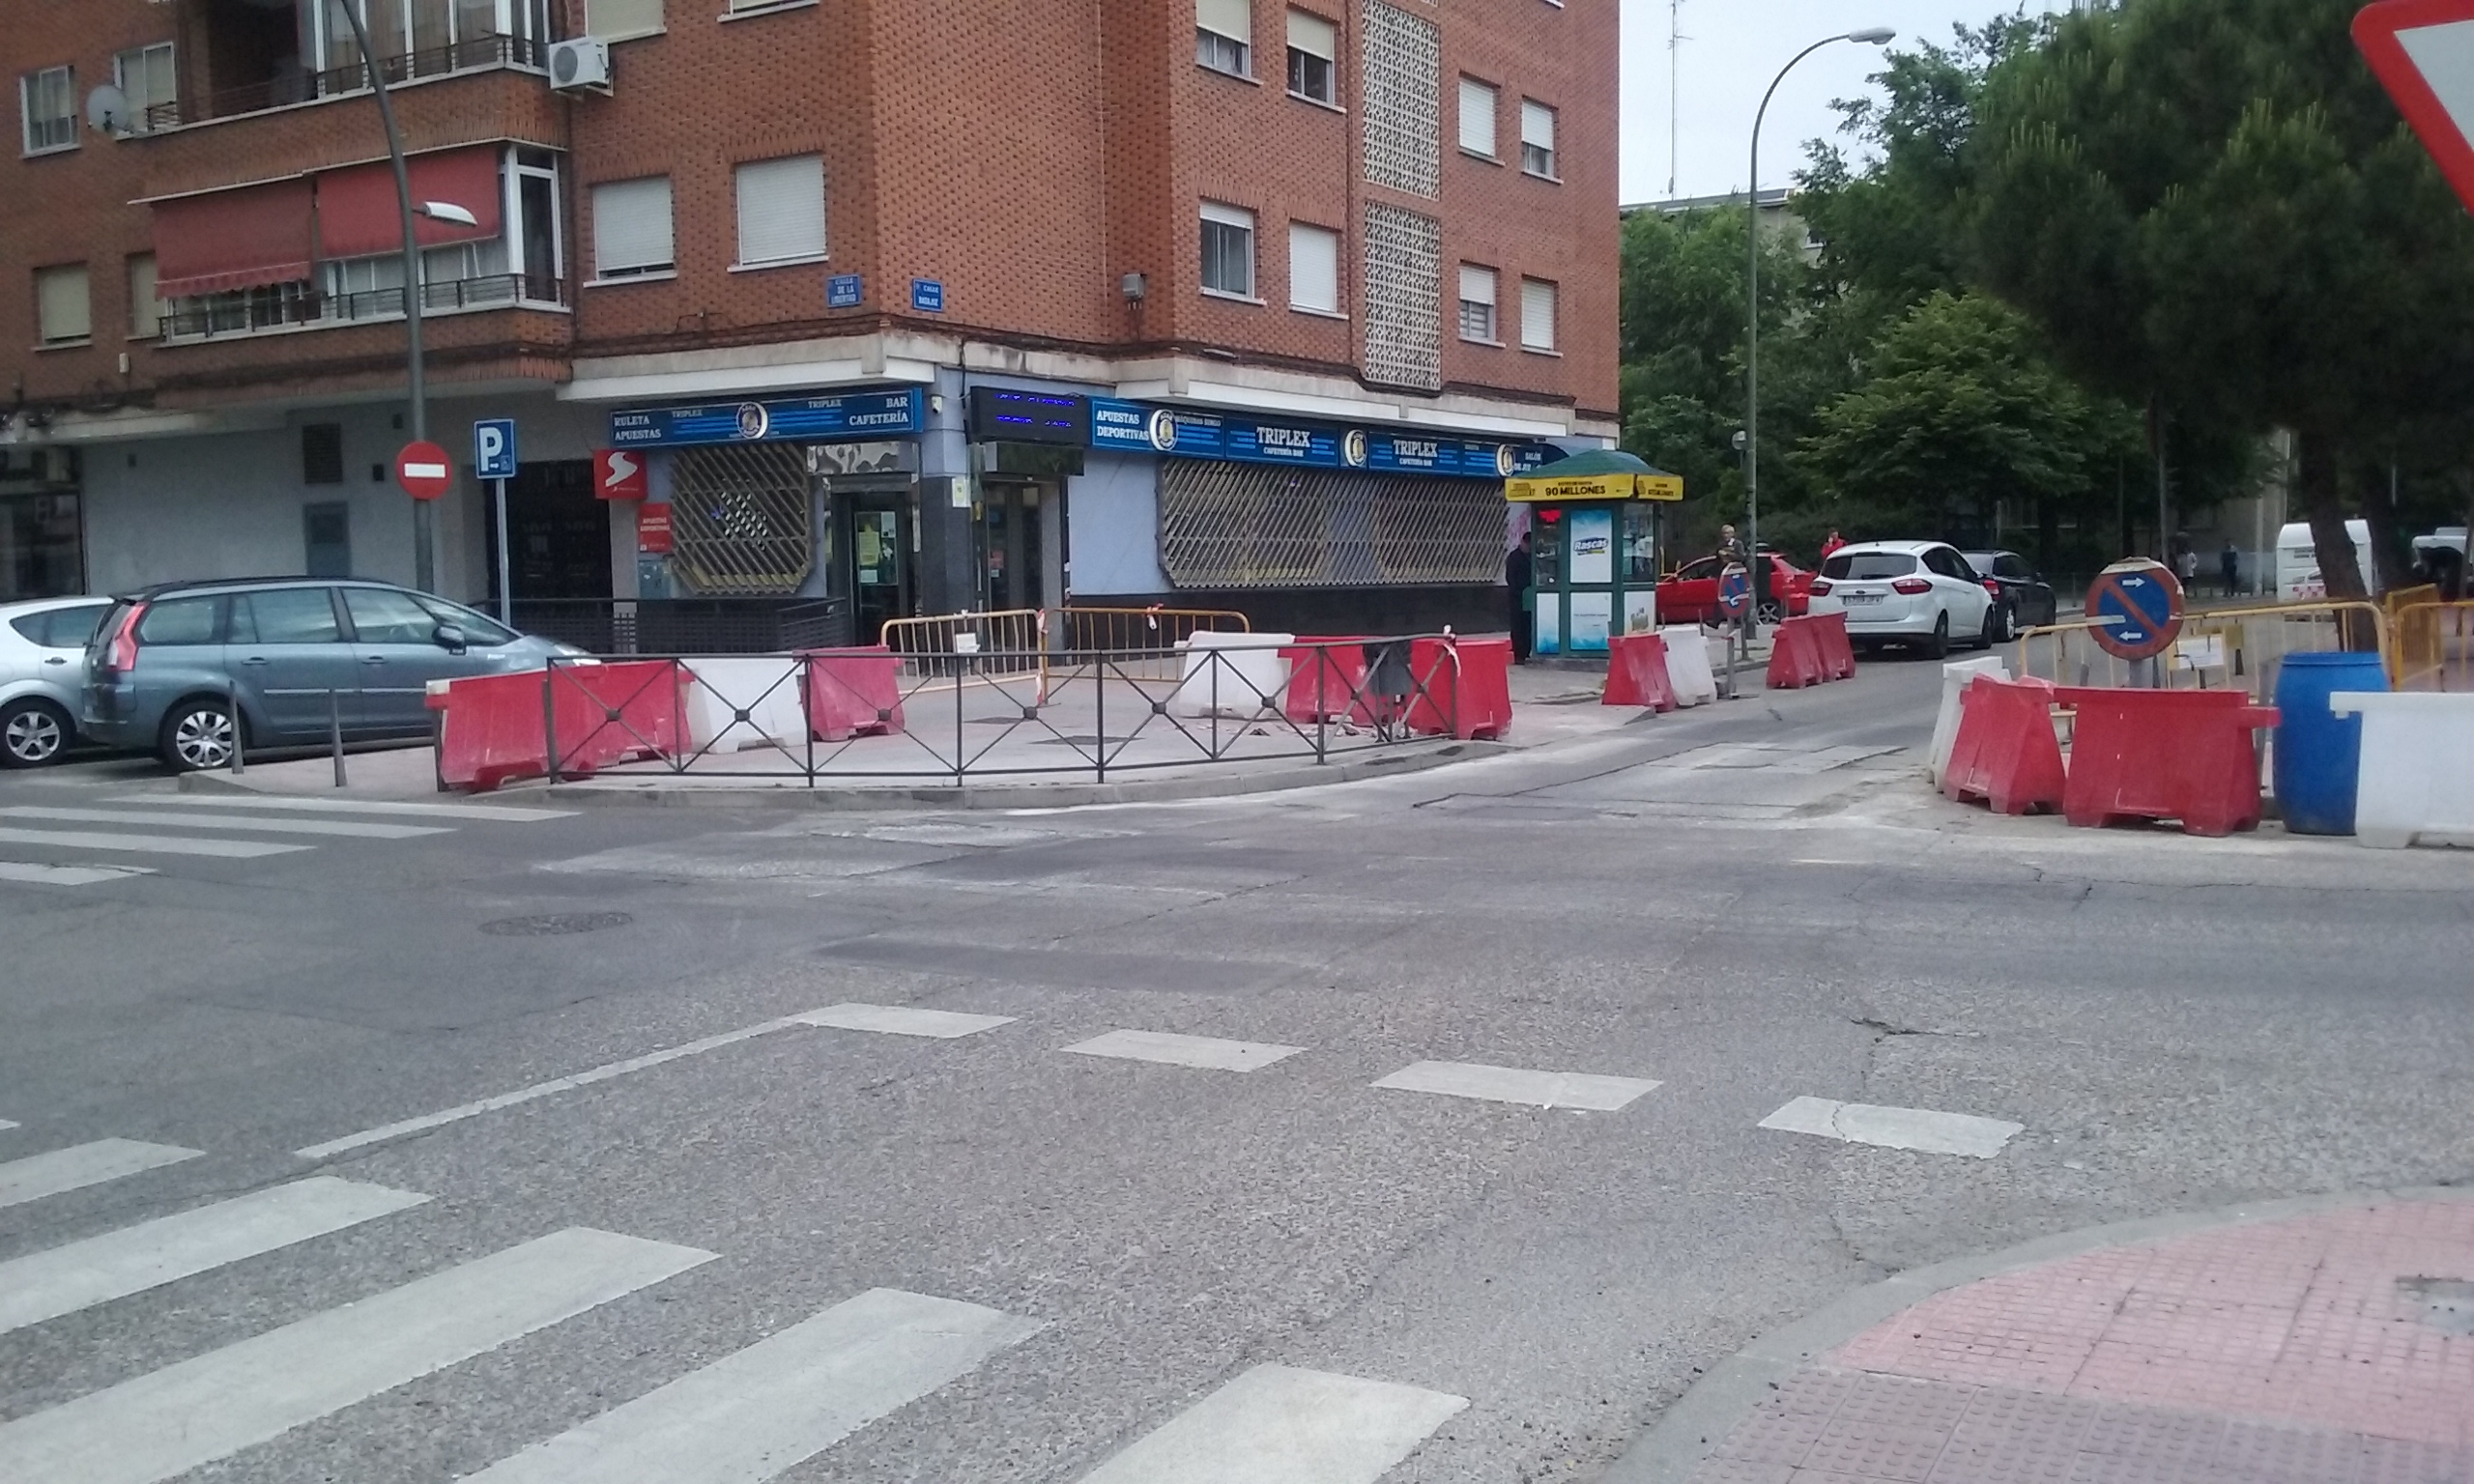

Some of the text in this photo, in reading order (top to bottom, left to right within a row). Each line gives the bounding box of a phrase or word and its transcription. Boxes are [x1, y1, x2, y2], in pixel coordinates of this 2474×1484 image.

[808, 399, 843, 409] TRIPLEX
[886, 396, 908, 408] BAR
[614, 415, 649, 427] RULETA
[849, 410, 908, 425] CAFETERÍA
[1096, 410, 1139, 425] APUESTAS
[615, 429, 661, 441] APUESTAS
[1097, 425, 1149, 441] DEPORTIVAS
[1256, 426, 1311, 448] TRIPLEX
[478, 427, 503, 471] P
[1393, 439, 1438, 458] TRIPLEX
[1545, 486, 1606, 497] 90 MILLONES
[1574, 538, 1608, 551] Rascas
